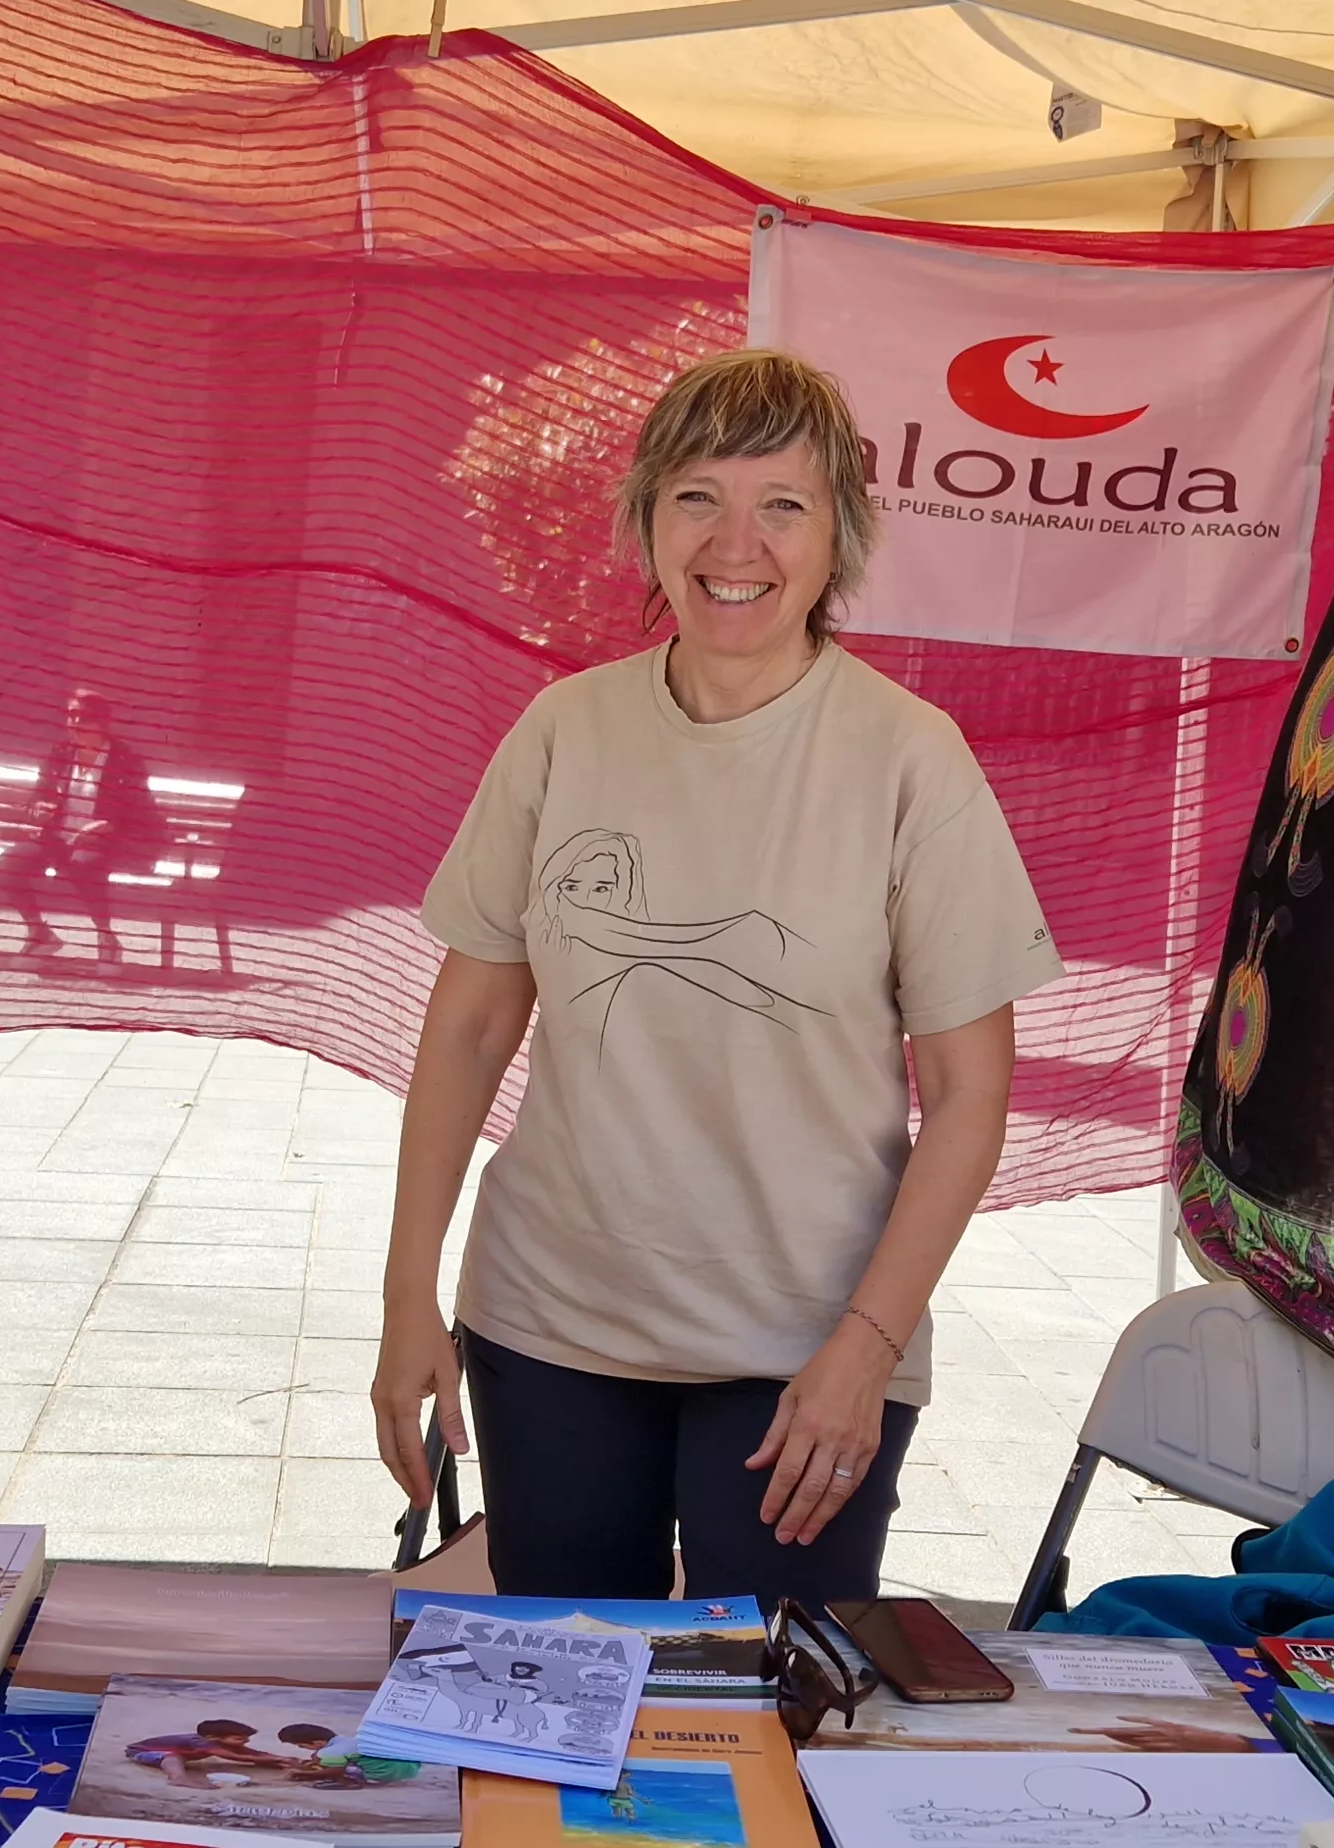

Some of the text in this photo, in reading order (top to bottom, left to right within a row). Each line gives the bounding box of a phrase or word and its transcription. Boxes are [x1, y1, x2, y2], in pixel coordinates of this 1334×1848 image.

[898, 499, 985, 522] PUEBLO
[990, 510, 1095, 532] SAHARAUI
[1099, 519, 1134, 535] DEL
[1138, 521, 1185, 537] ALTO
[1190, 521, 1281, 538] ARAGÓN
[460, 1622, 628, 1665] SAHARA
[653, 1668, 727, 1676] SOBREVIVIR
[654, 1731, 740, 1744] DESIERTO
